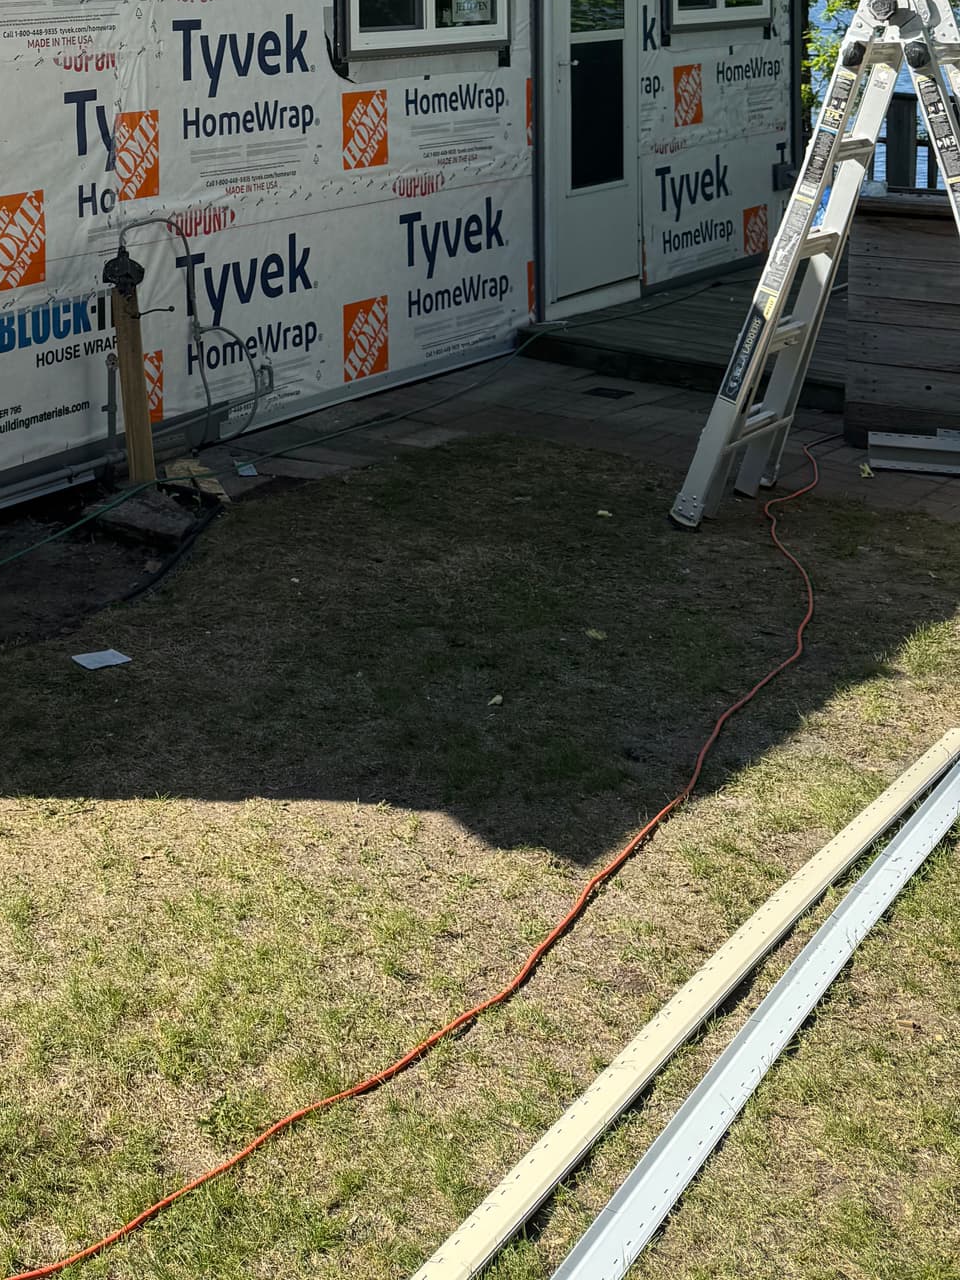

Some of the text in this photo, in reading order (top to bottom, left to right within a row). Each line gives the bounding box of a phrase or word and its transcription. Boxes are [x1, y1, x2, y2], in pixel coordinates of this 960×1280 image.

[2, 30, 14, 39] Call
[27, 38, 51, 49] MADE
[61, 36, 76, 46] THE
[77, 35, 94, 45] USA
[172, 13, 309, 99] Tyvek
[717, 57, 781, 84] HomeWrap
[183, 100, 314, 140] HomeWrap
[346, 99, 366, 130] THE
[405, 83, 505, 117] HomeWrap
[342, 89, 388, 169] HOME
[361, 119, 388, 168] DEPOT
[655, 154, 729, 223] Tyvek
[5, 217, 47, 291] DEPOT
[399, 197, 504, 280] Tyvek
[662, 218, 733, 255] HomeWrap
[175, 232, 312, 327] Tyvek
[407, 274, 509, 319] HomeWrap
[36, 344, 81, 368] HOUSE
[187, 320, 318, 375] HomeWrap
[344, 296, 388, 381] HOME
